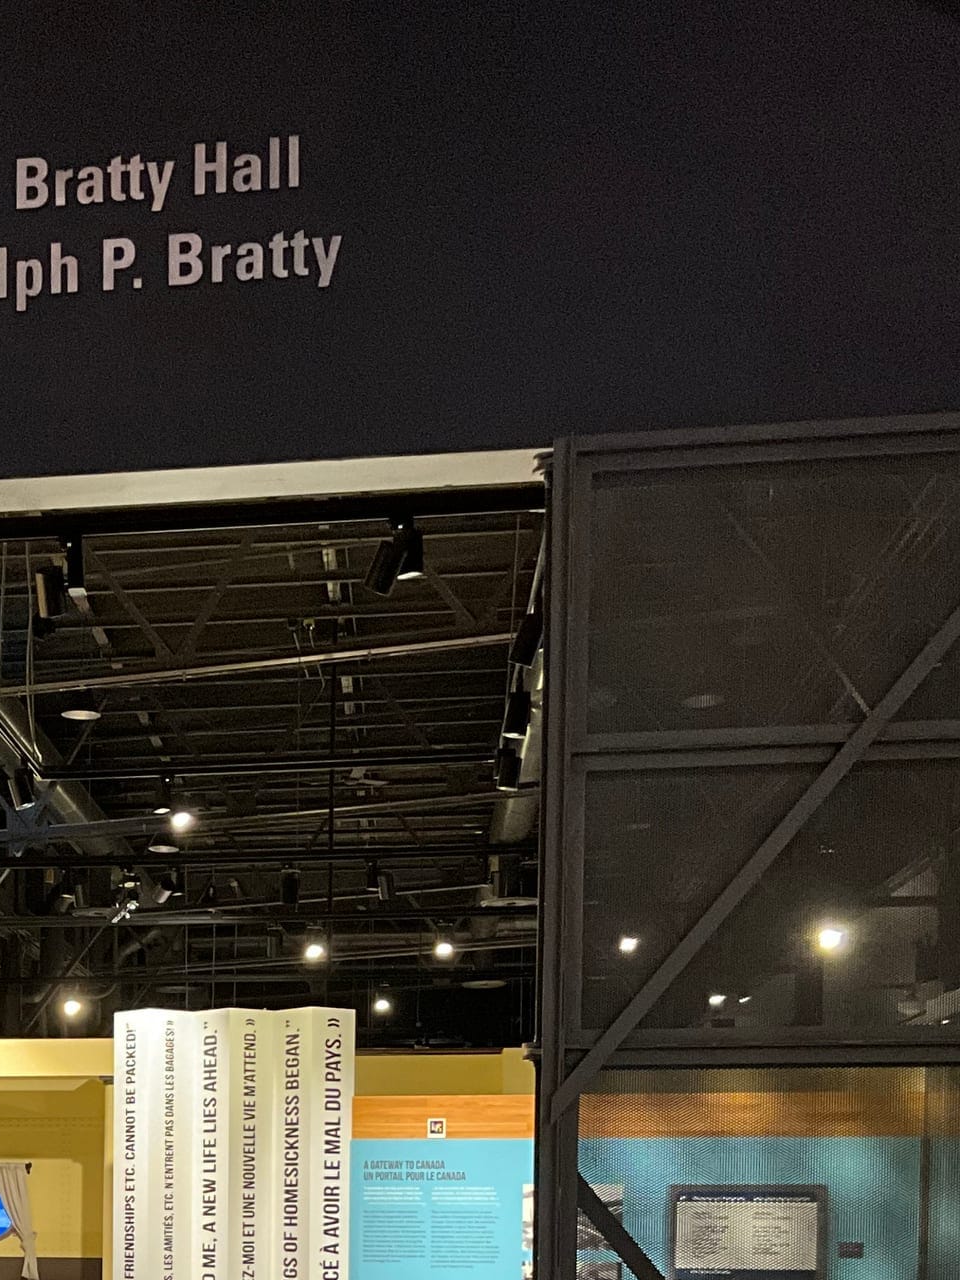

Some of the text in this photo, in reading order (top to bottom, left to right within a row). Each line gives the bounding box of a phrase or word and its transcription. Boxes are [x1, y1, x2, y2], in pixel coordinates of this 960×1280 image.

[15, 153, 176, 212] Bratty
[194, 134, 301, 196] Hall
[102, 238, 143, 292] P.
[167, 229, 343, 288] Bratty
[325, 1034, 342, 1082] PAYS.
[165, 1075, 174, 1090] LES
[126, 1088, 135, 1104] BE
[165, 1094, 174, 1117] DANS
[325, 1088, 341, 1111] DU
[203, 1098, 217, 1133] LIES
[244, 1101, 255, 1120] VIE
[125, 1108, 135, 1160] CANNOT
[165, 1120, 174, 1137] PAS
[324, 1117, 341, 1154] MAL
[203, 1138, 216, 1173] LIFE
[243, 1125, 255, 1189] NOUVELLE
[284, 1096, 299, 1226] HOMESICKNESS
[363, 1160, 445, 1169] A GATEWAY TO CANADA
[323, 1160, 340, 1180] LE
[363, 1171, 466, 1181] UN PORTAIL POUR LE CANADA
[203, 1179, 216, 1216] NEW
[243, 1192, 255, 1218] UNE
[323, 1186, 339, 1237] AVOIR
[124, 1196, 135, 1279] FRIENDSHIPS
[203, 1222, 216, 1232] A
[243, 1222, 254, 1236] ET
[202, 1238, 217, 1268] ME,
[284, 1232, 297, 1252] OF
[320, 1244, 339, 1254] À
[164, 1255, 172, 1270] LES
